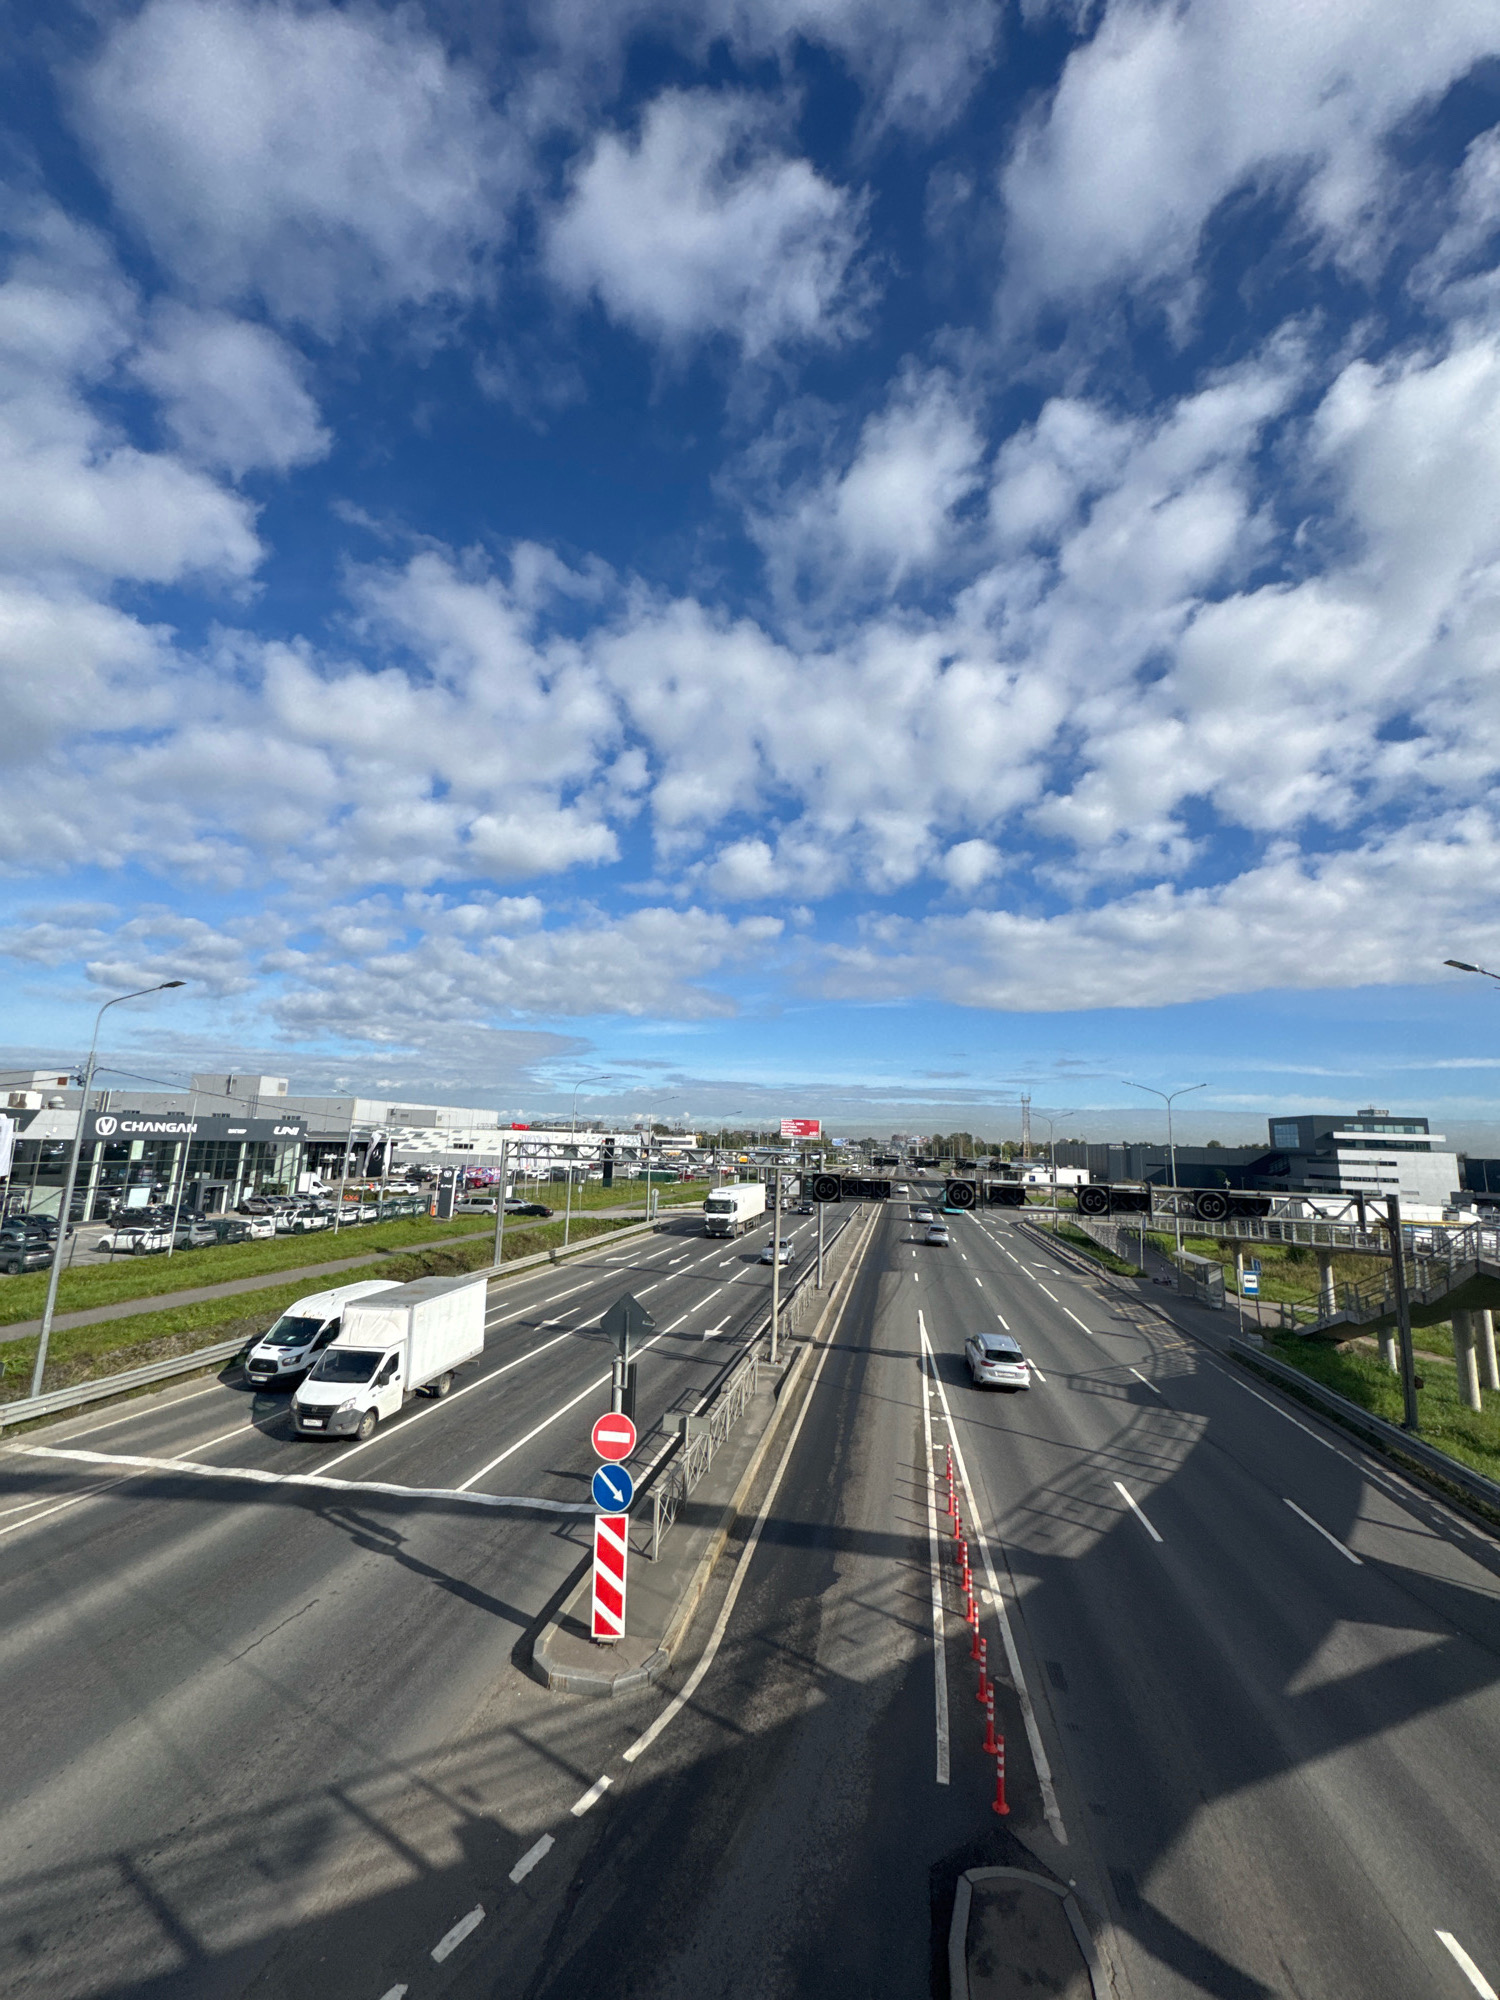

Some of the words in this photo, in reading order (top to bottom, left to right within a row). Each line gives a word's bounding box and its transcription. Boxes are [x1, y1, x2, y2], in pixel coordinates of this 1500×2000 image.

[121, 1120, 198, 1133] CHANGAN
[273, 1126, 300, 1136] UNI
[819, 1183, 834, 1194] 60
[953, 1189, 968, 1201] 60
[1085, 1195, 1102, 1207] 60
[1203, 1200, 1220, 1212] 60
